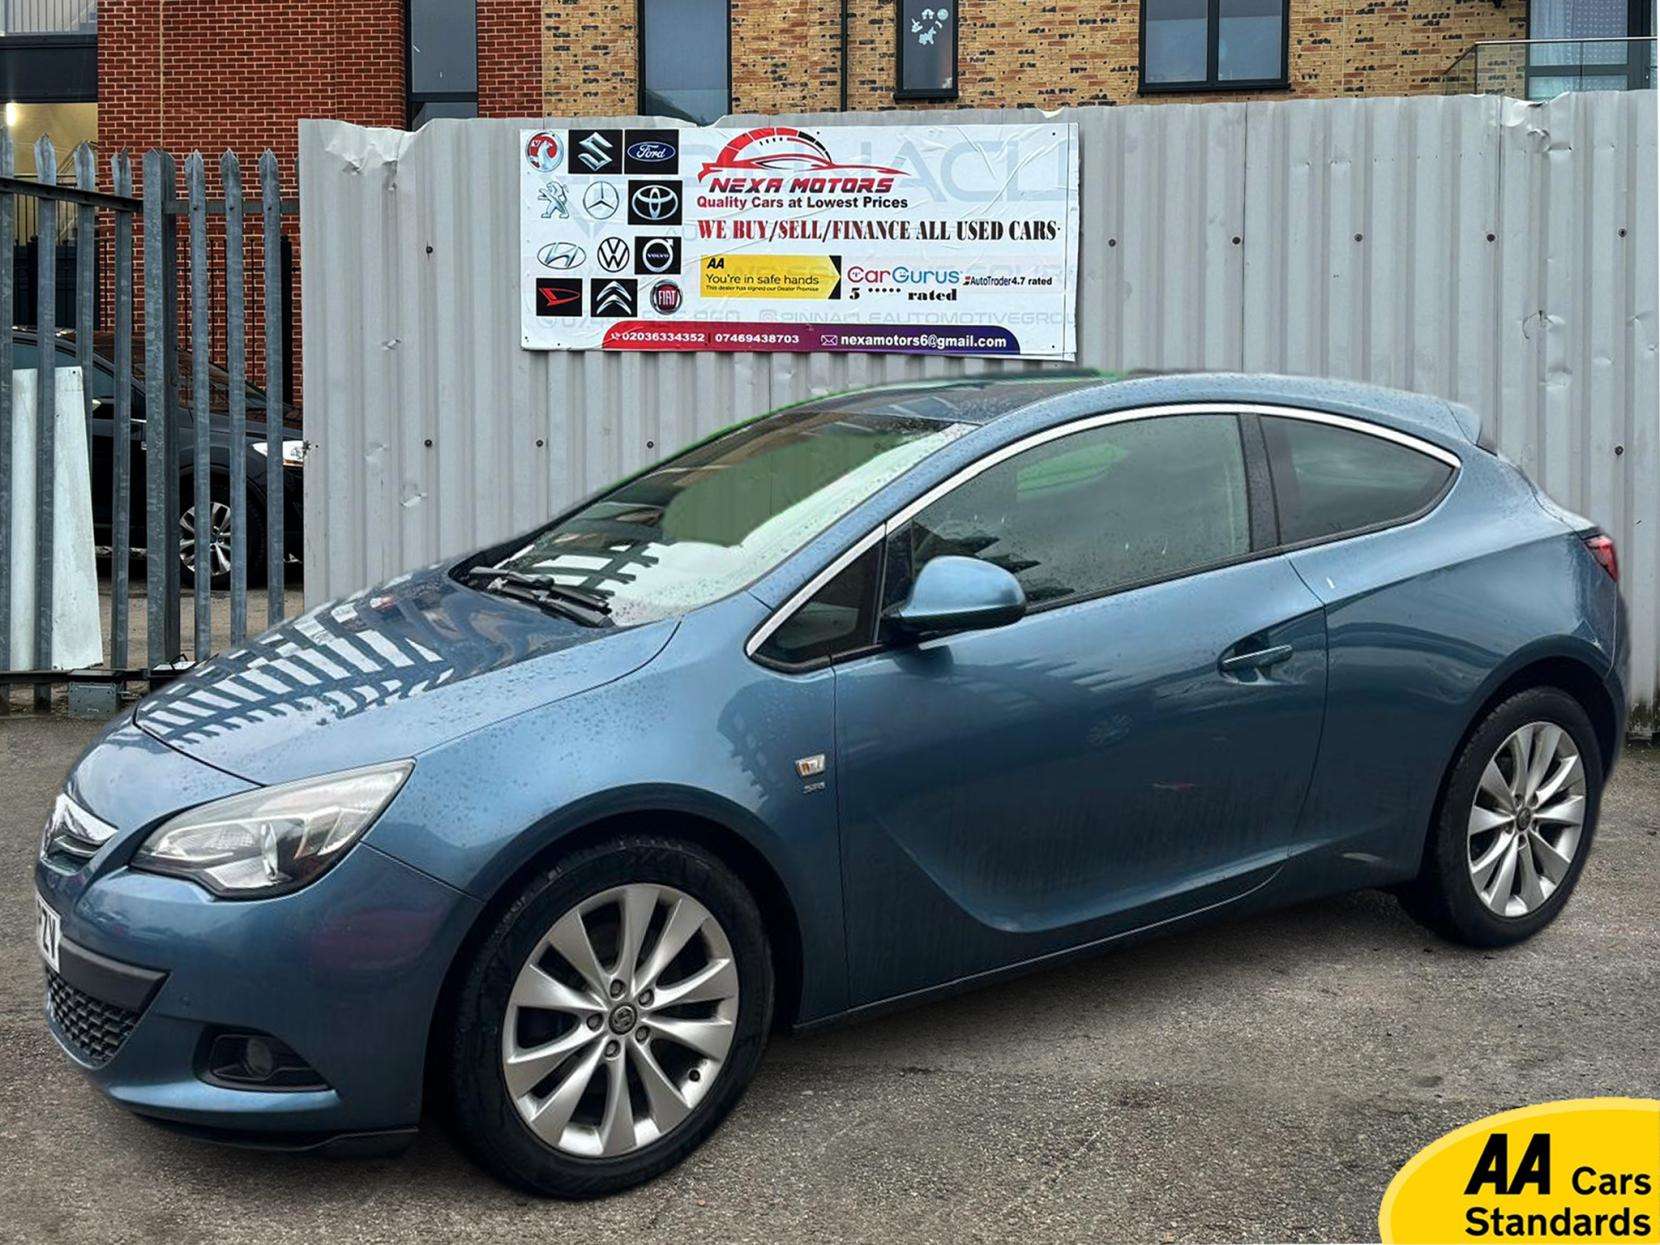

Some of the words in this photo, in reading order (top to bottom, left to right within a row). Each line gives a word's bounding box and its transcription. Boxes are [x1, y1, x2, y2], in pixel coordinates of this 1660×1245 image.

[636, 144, 666, 158] Ford
[708, 177, 784, 194] NEXA
[789, 177, 895, 194] MOTORS
[697, 196, 747, 210] Quality
[752, 196, 784, 209] Cars
[788, 197, 802, 208] at
[807, 196, 858, 209] Lowest
[863, 196, 908, 209] Prices
[697, 219, 726, 239] WE
[733, 219, 910, 242] BUY/SELL/FINANCE
[916, 220, 950, 240] ALL
[956, 220, 1004, 240] USED
[1009, 220, 1057, 240] CARS
[706, 256, 725, 270] AA
[706, 273, 741, 284] You're
[744, 274, 754, 284] in
[757, 273, 781, 285] safe
[784, 274, 820, 285] hands
[847, 265, 960, 284] CarGurus
[1028, 276, 1053, 286] rated
[658, 290, 677, 306] FIAT
[849, 287, 861, 301] 5
[908, 288, 958, 301] rated
[622, 331, 705, 342] 02036334352
[714, 333, 800, 344] 07469438703
[840, 334, 1007, 349] nexamotors6@gmail.com
